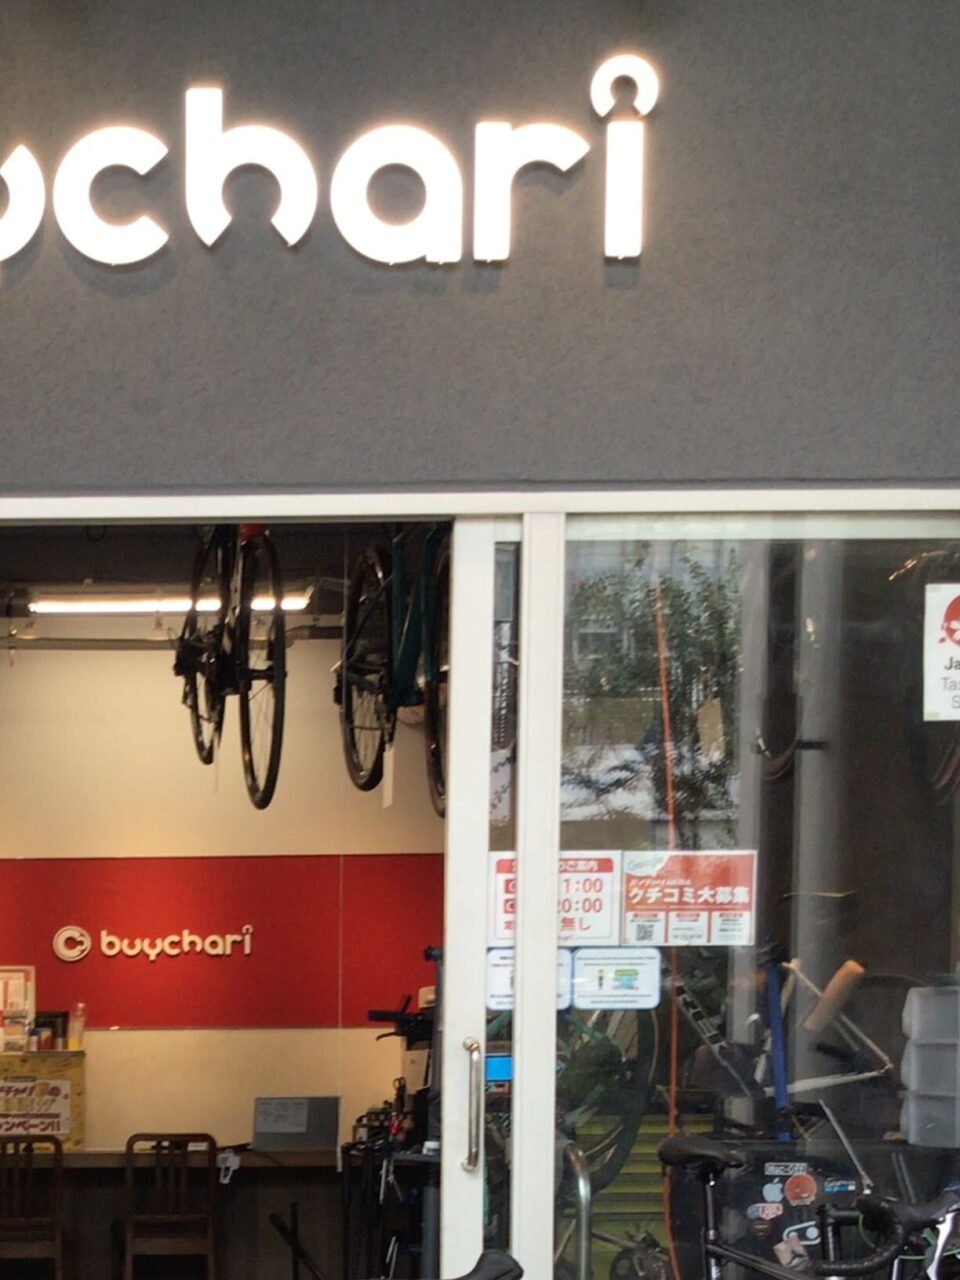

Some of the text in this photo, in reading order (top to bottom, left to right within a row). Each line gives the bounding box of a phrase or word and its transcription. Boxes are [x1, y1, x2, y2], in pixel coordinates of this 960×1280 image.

[628, 886, 750, 904] クチコミ大募集
[100, 924, 254, 961] buychari
